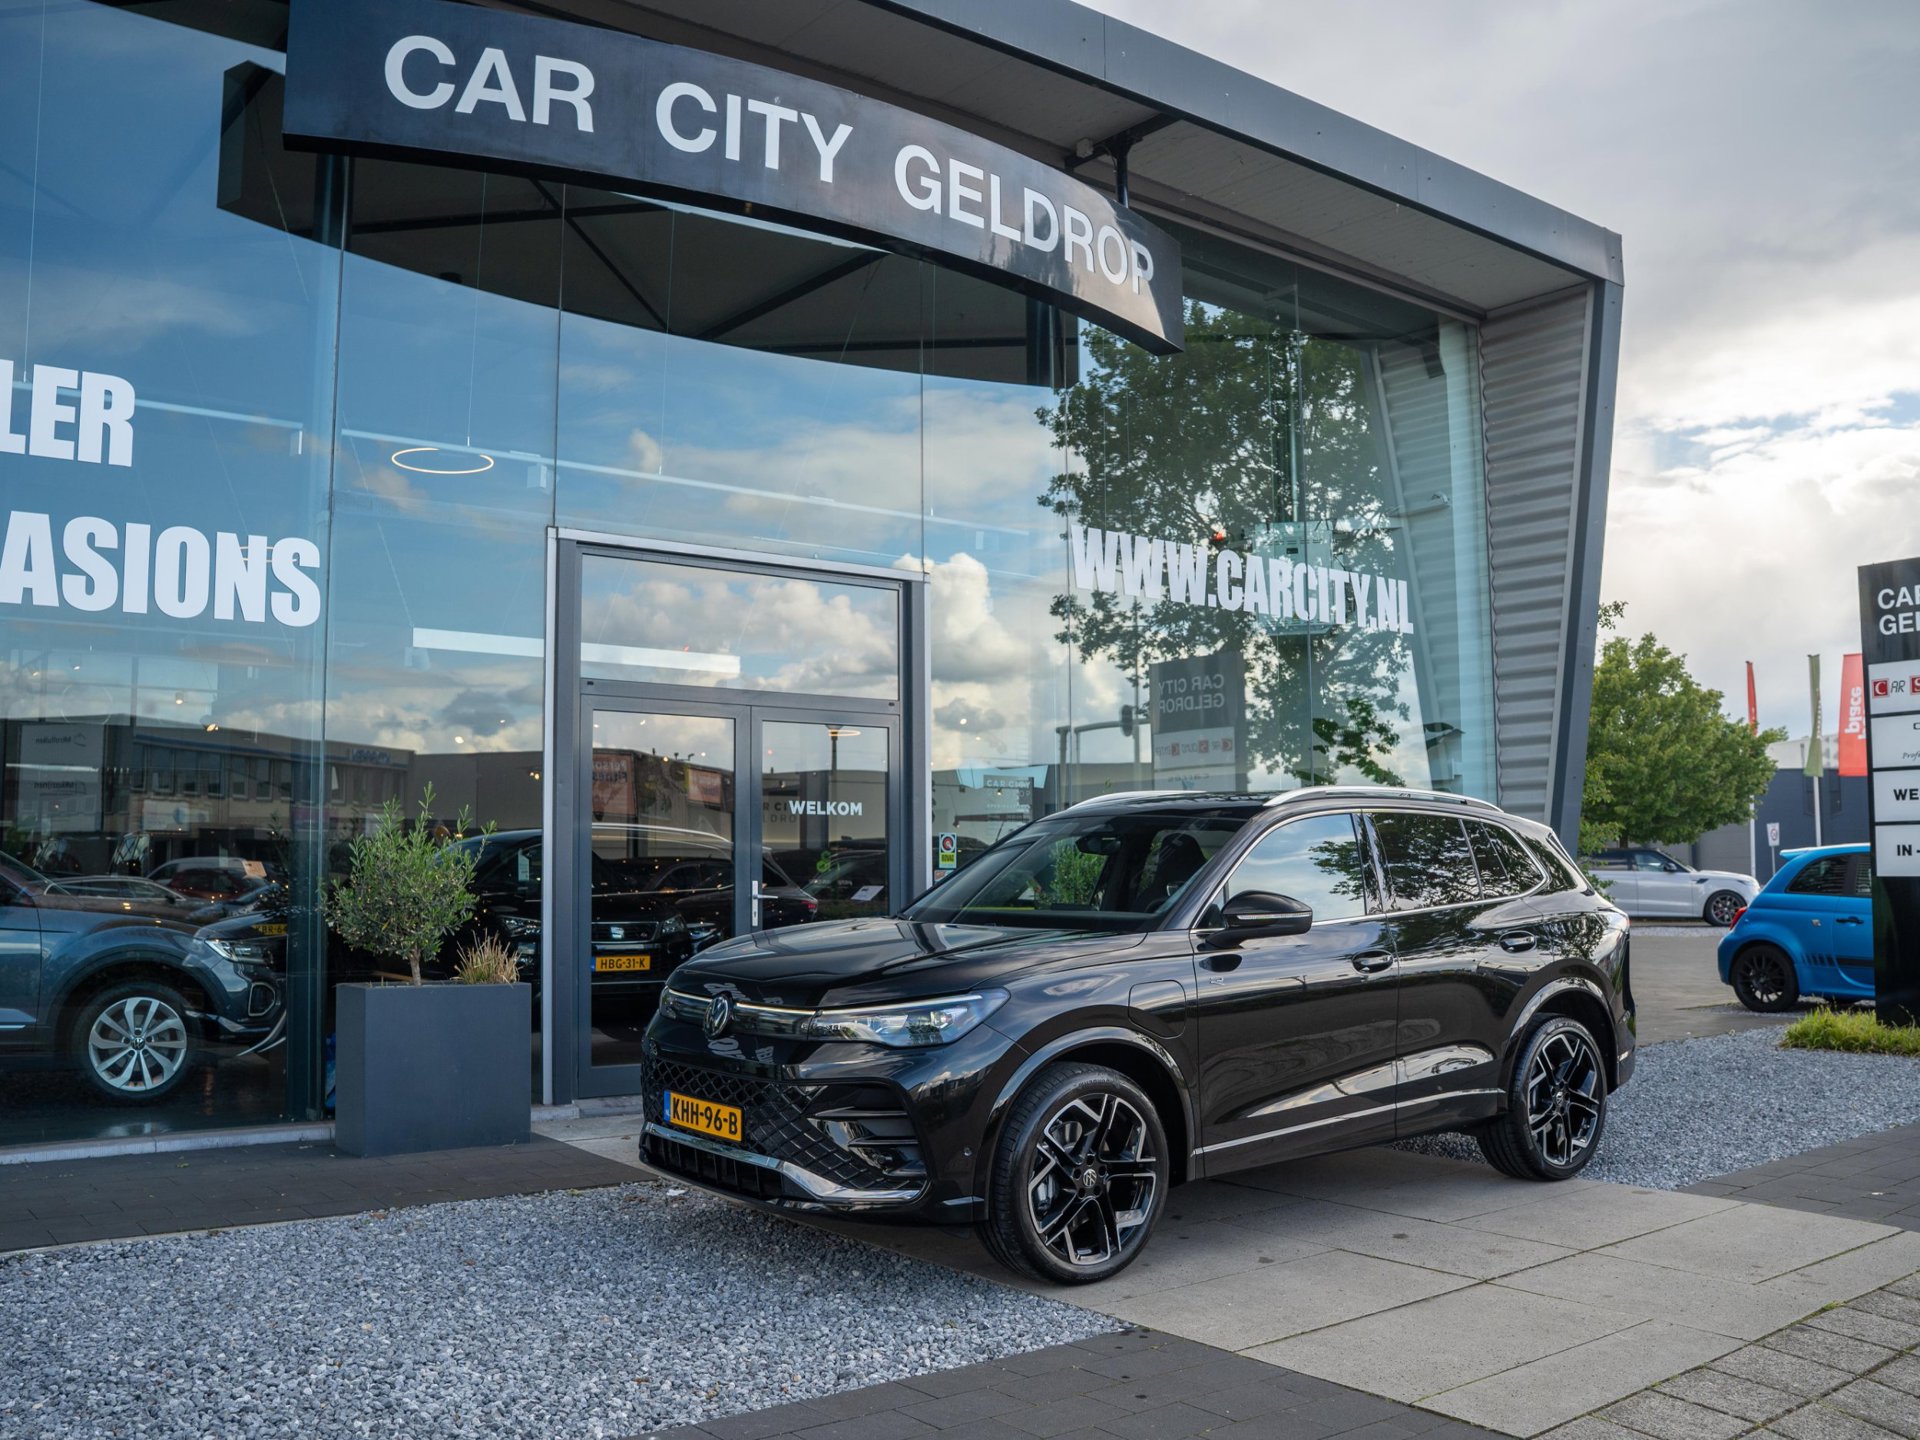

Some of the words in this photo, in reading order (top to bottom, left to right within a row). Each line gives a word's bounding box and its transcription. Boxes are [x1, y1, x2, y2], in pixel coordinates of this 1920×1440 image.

[384, 35, 595, 133] CAR
[656, 81, 854, 184] CITY
[894, 144, 1154, 295] GELDROP
[0, 510, 320, 627] ASIONS
[1071, 524, 1414, 635] WWW.CARCITY.NL
[1879, 611, 1920, 636] GE
[788, 800, 863, 816] WELKOM
[600, 957, 646, 970] HBG-31-K
[672, 1097, 738, 1135] KHH-96-B
